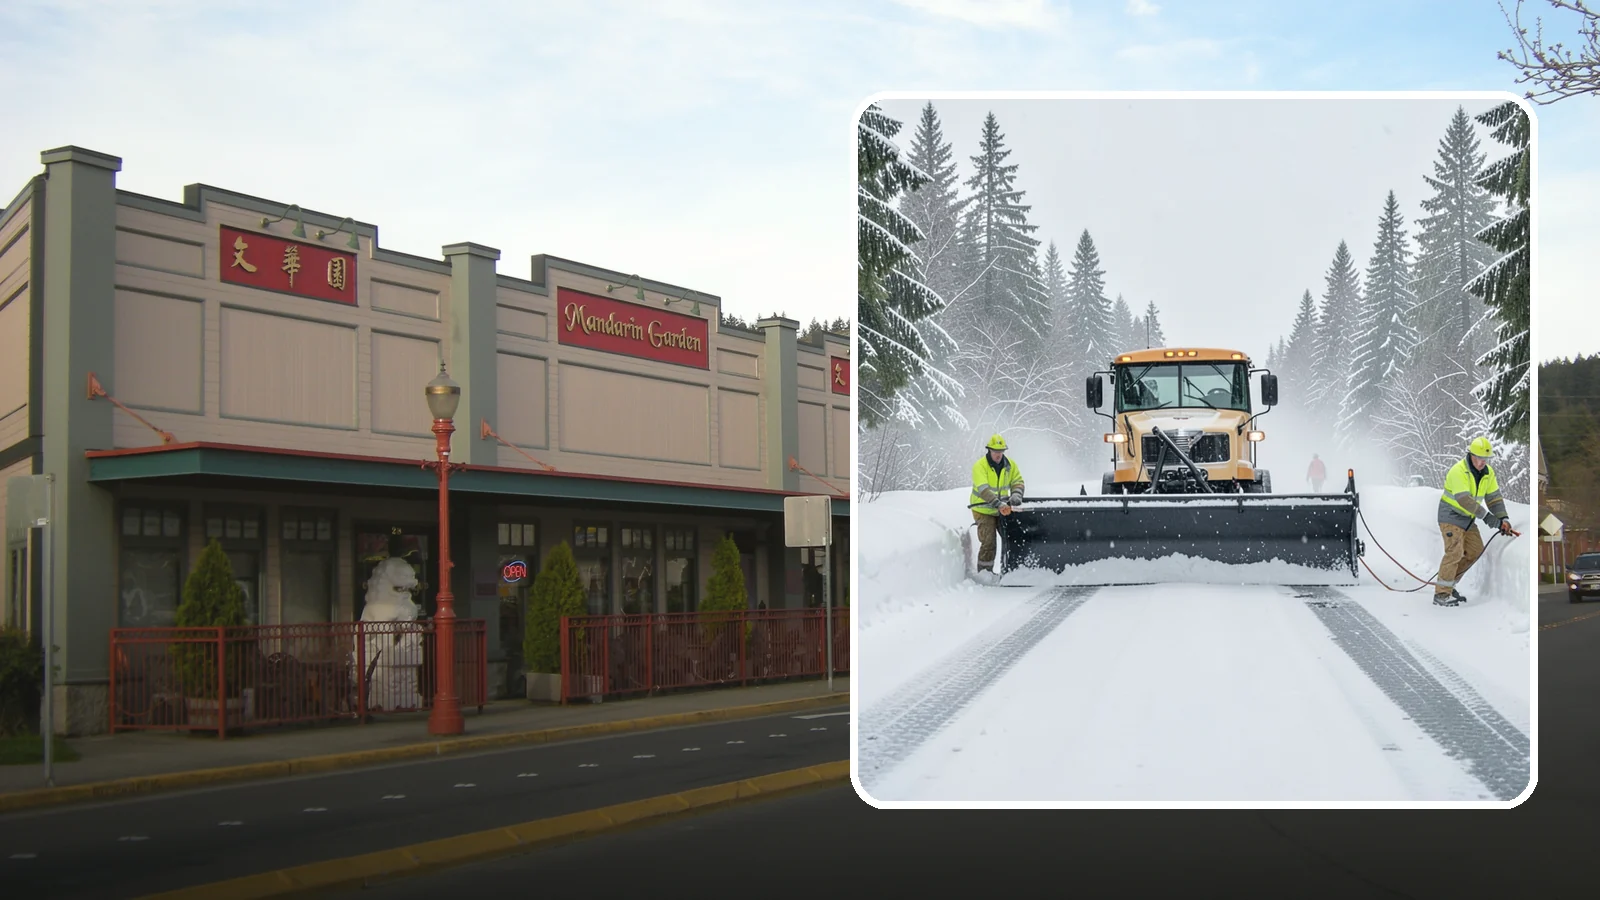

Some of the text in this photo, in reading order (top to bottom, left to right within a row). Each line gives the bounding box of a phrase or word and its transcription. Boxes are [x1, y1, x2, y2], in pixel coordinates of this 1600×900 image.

[230, 235, 346, 291] 文華園
[564, 302, 702, 352] Mandarin Garden
[503, 565, 527, 578] OPEN
